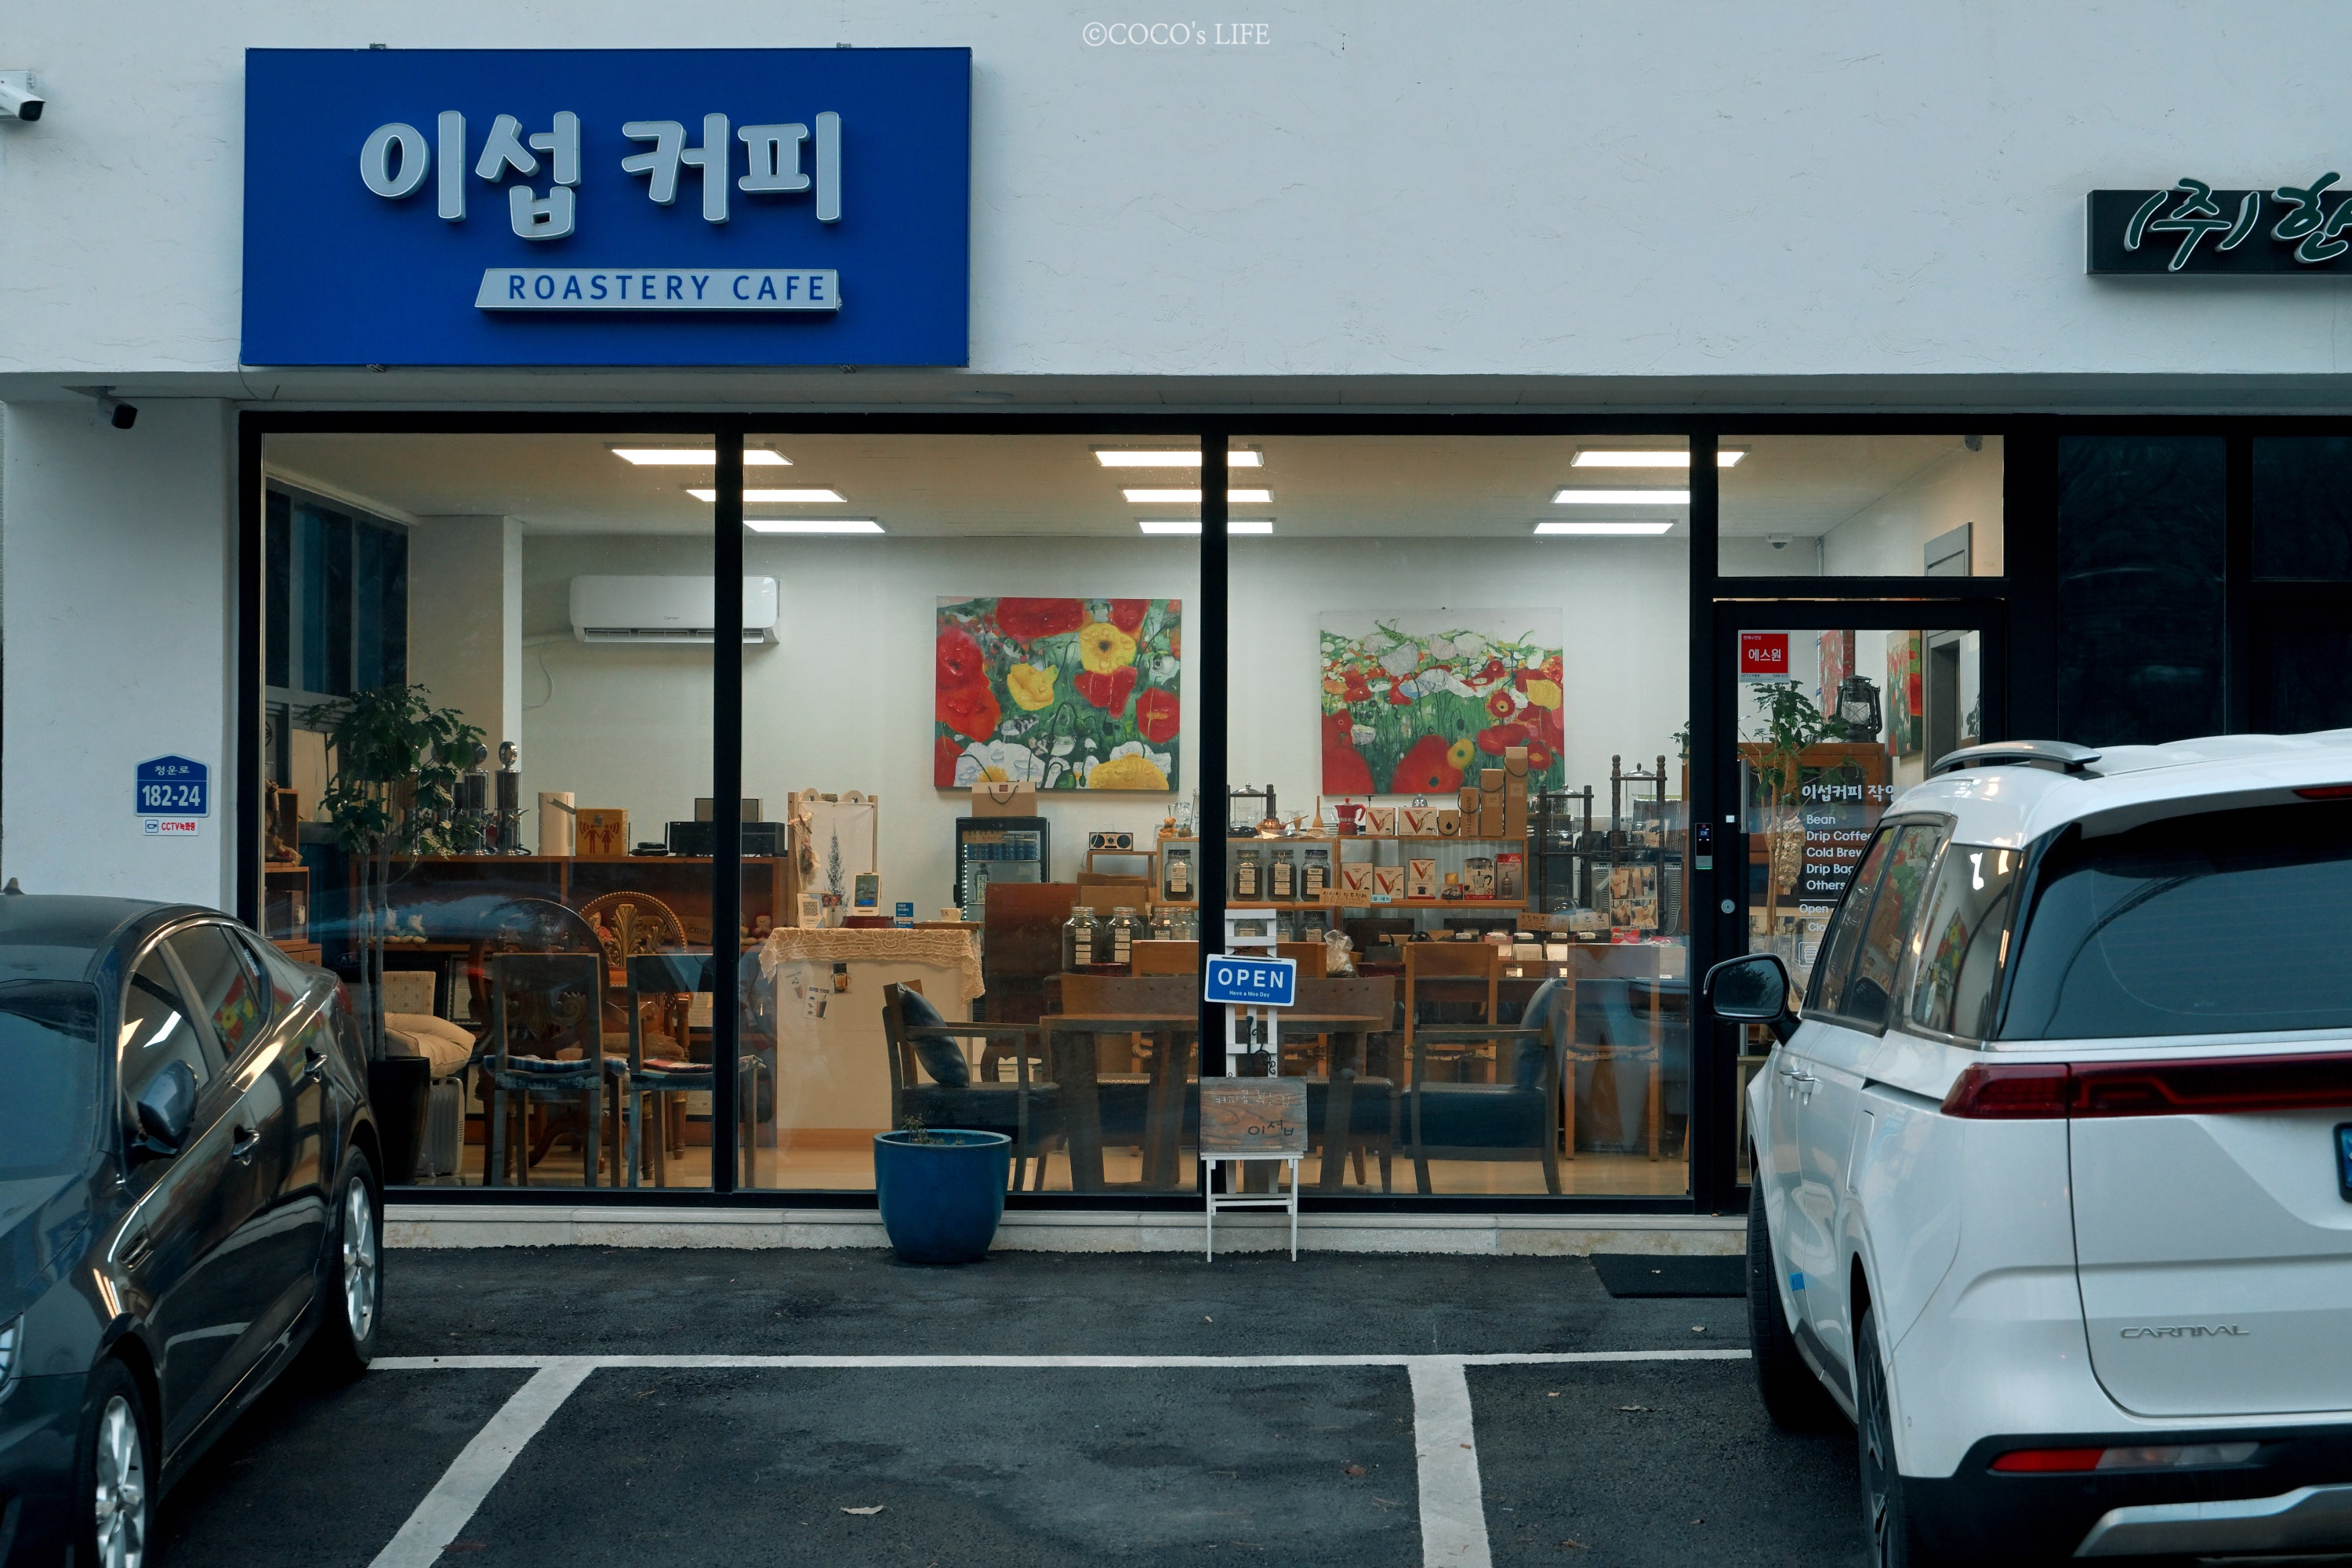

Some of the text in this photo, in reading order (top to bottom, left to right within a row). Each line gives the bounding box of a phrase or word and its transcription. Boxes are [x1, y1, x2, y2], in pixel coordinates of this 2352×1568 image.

[360, 111, 842, 241] 이섭 커피
[508, 274, 826, 301] ROASTERY CAFE
[1748, 648, 1781, 662] 에스원
[142, 785, 201, 807] 182-24
[1802, 784, 1862, 802] 이섭커피
[1806, 815, 1836, 826] Bean
[1806, 831, 1831, 843] Drip
[1806, 848, 1834, 858] Cold
[1806, 864, 1831, 877] Drip
[1806, 880, 1846, 891] Others
[1799, 904, 1829, 915] Open
[1808, 922, 1827, 932] Clo
[1218, 967, 1284, 989] OPEN
[2119, 1323, 2250, 1339] CARNIVAL
